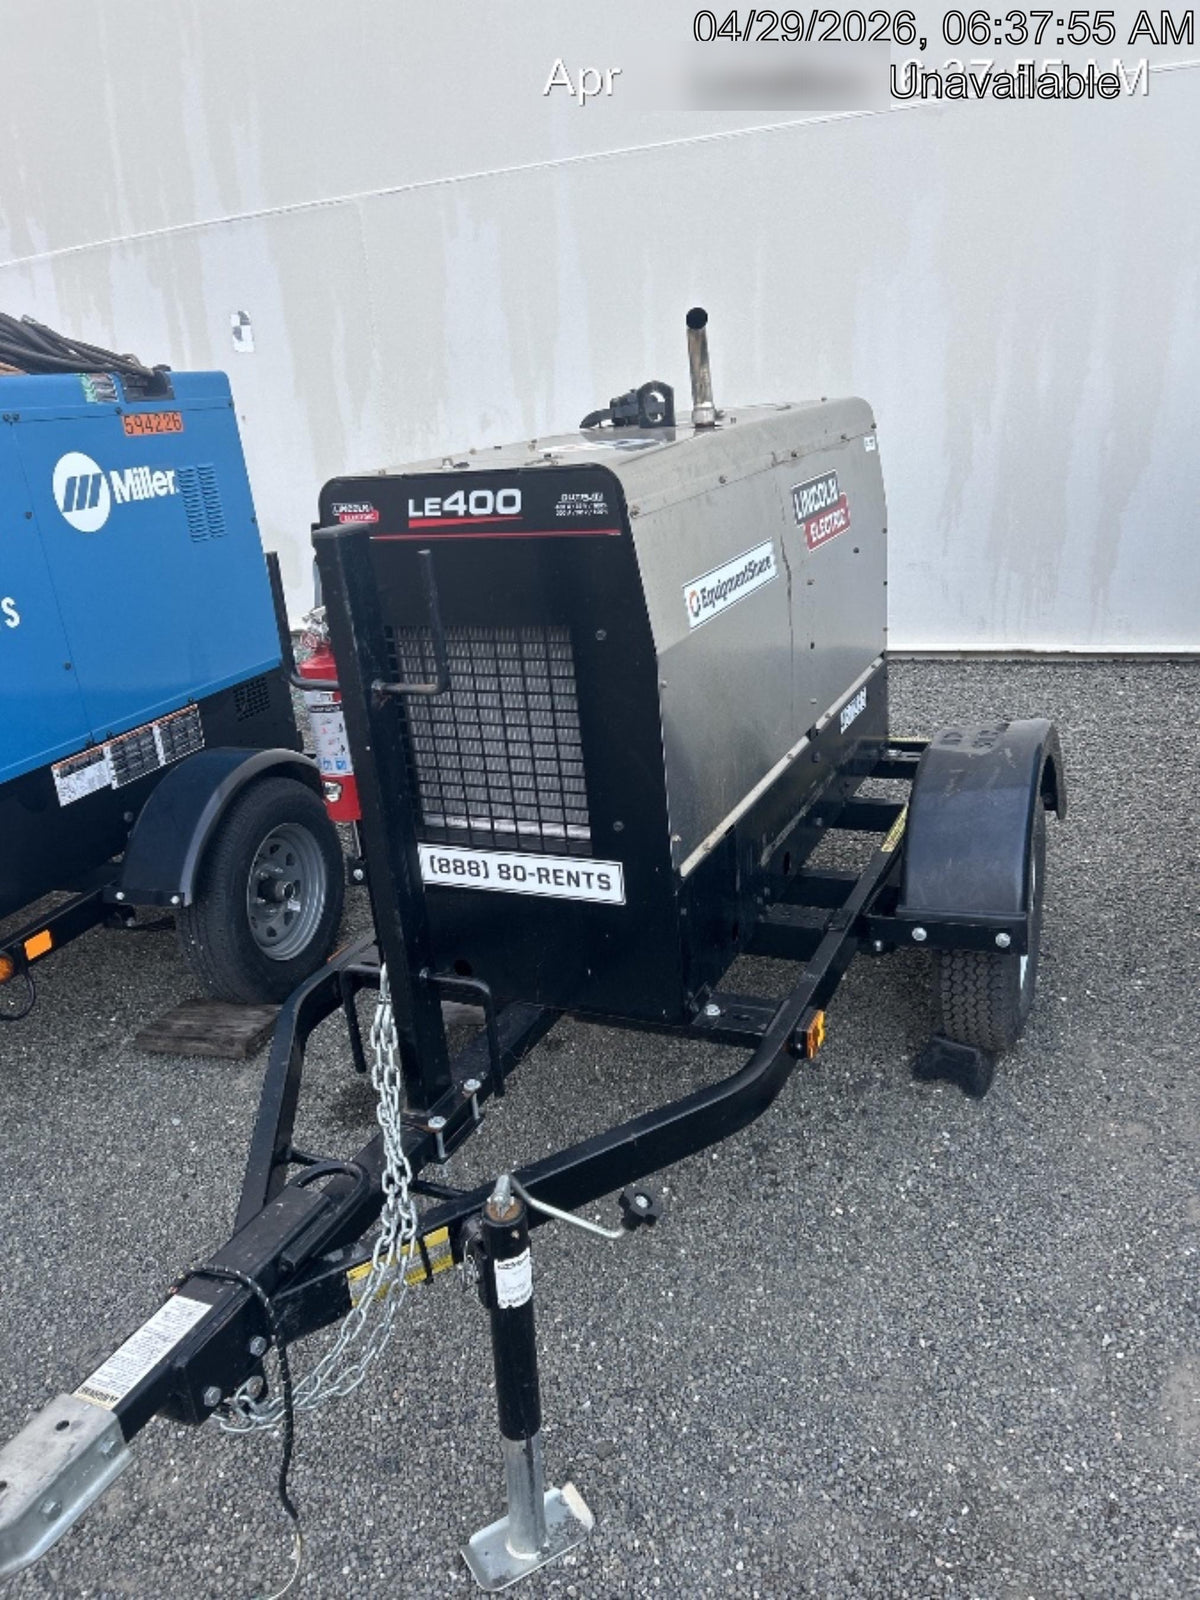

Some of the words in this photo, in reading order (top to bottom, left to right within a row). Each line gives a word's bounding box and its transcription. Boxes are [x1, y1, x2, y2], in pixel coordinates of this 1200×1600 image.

[123, 412, 182, 434] 594226
[408, 488, 522, 518] LE400
[429, 854, 489, 878] (888)
[497, 863, 611, 891] 80-RENTS
